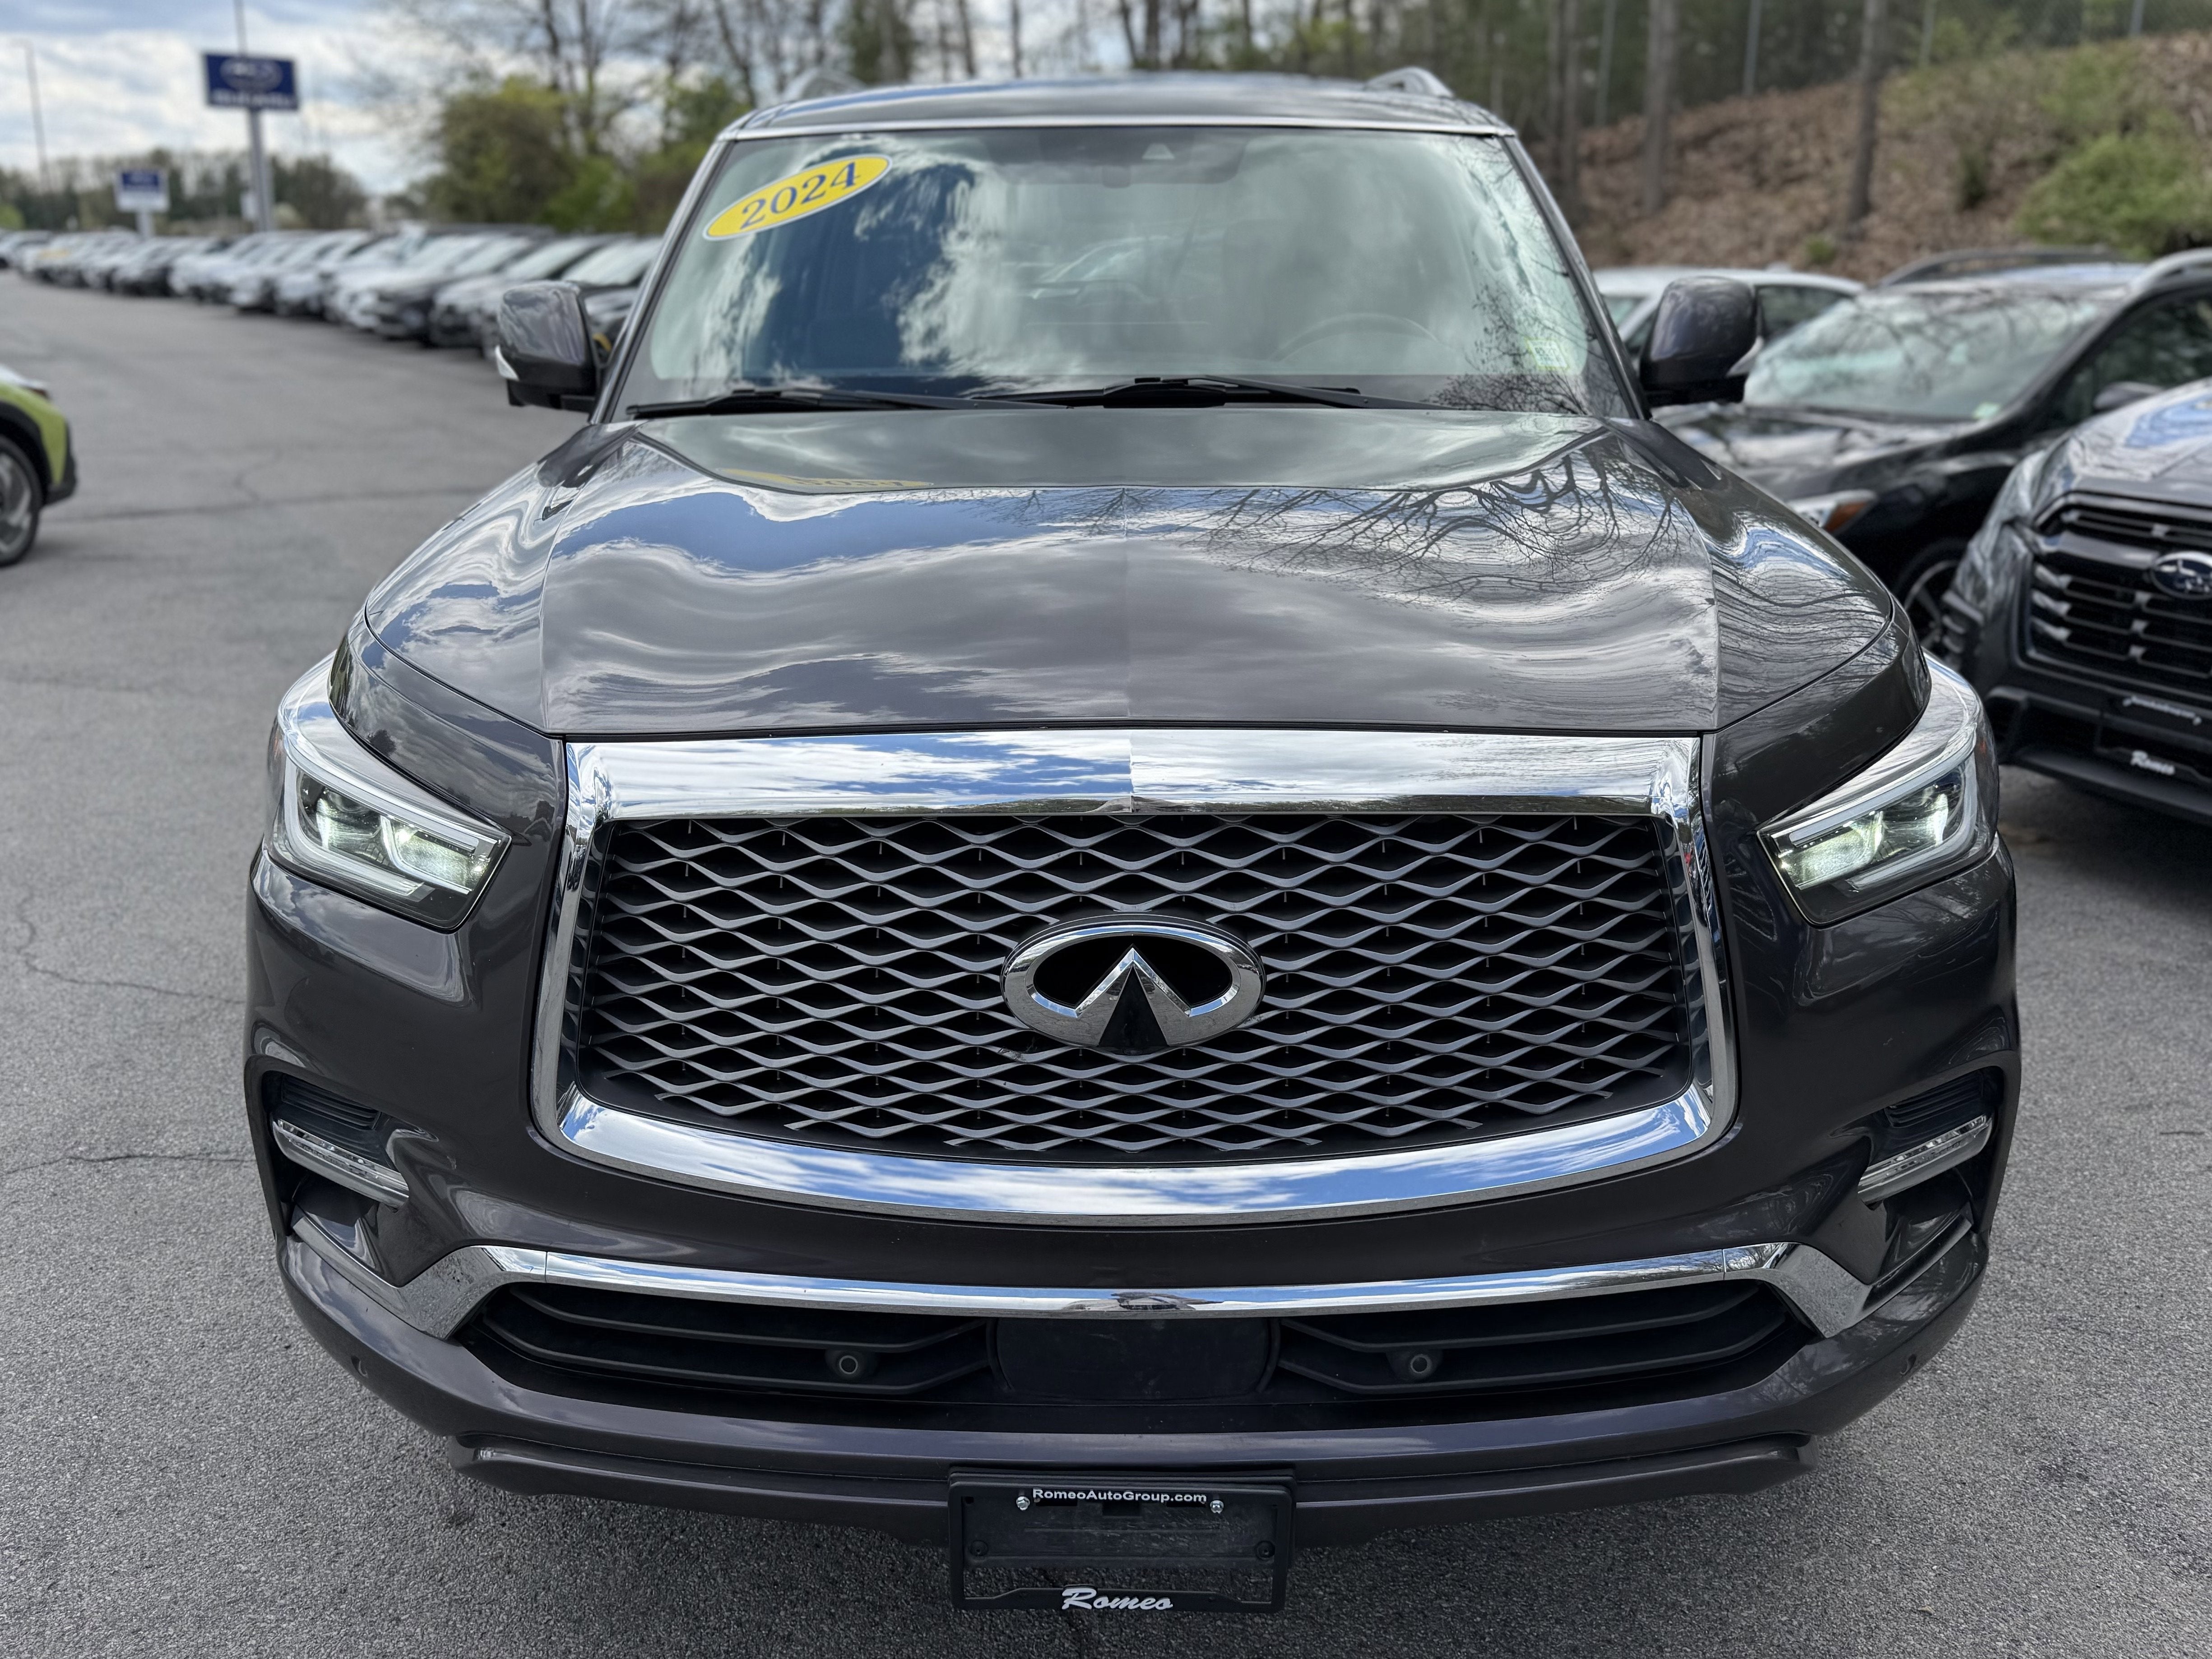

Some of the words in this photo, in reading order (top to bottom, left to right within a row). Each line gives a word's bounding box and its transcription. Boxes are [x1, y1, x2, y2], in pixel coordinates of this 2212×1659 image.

[740, 162, 860, 230] 2024
[1033, 1488, 1206, 1503] RomeoAutoGroup.com
[1062, 1588, 1173, 1610] Romeo
